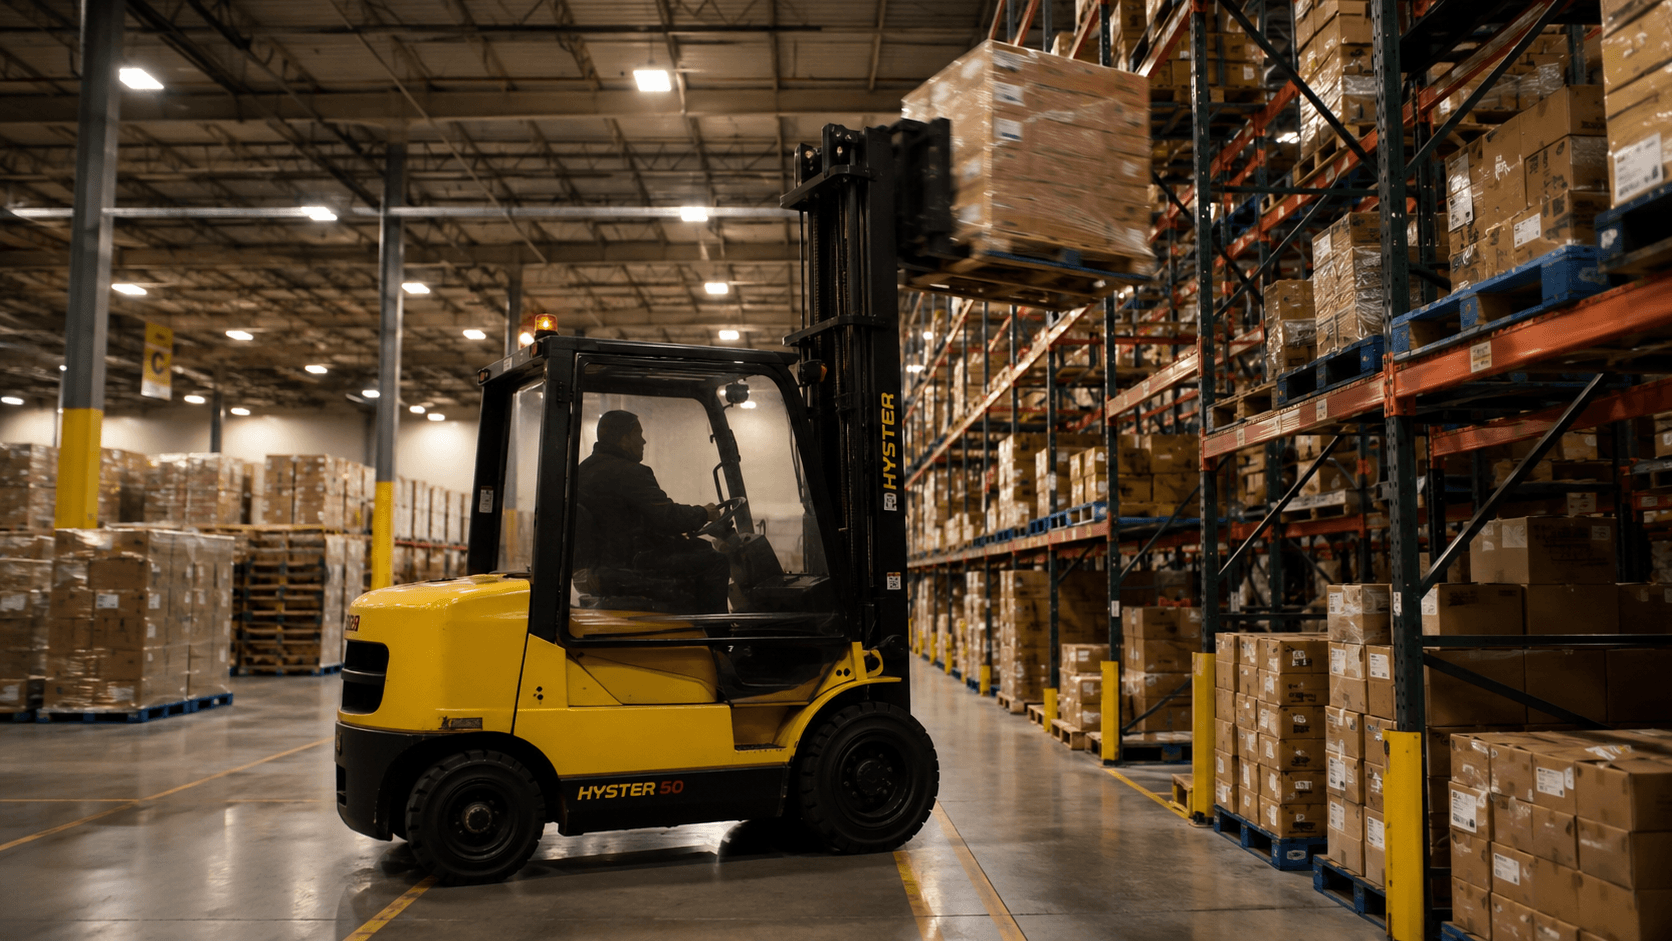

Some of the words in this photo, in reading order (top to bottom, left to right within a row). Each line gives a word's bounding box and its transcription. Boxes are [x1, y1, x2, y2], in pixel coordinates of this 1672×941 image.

[152, 351, 164, 374] C
[881, 392, 897, 490] HYSTER
[577, 782, 656, 801] HYSTER
[660, 780, 684, 795] 50
